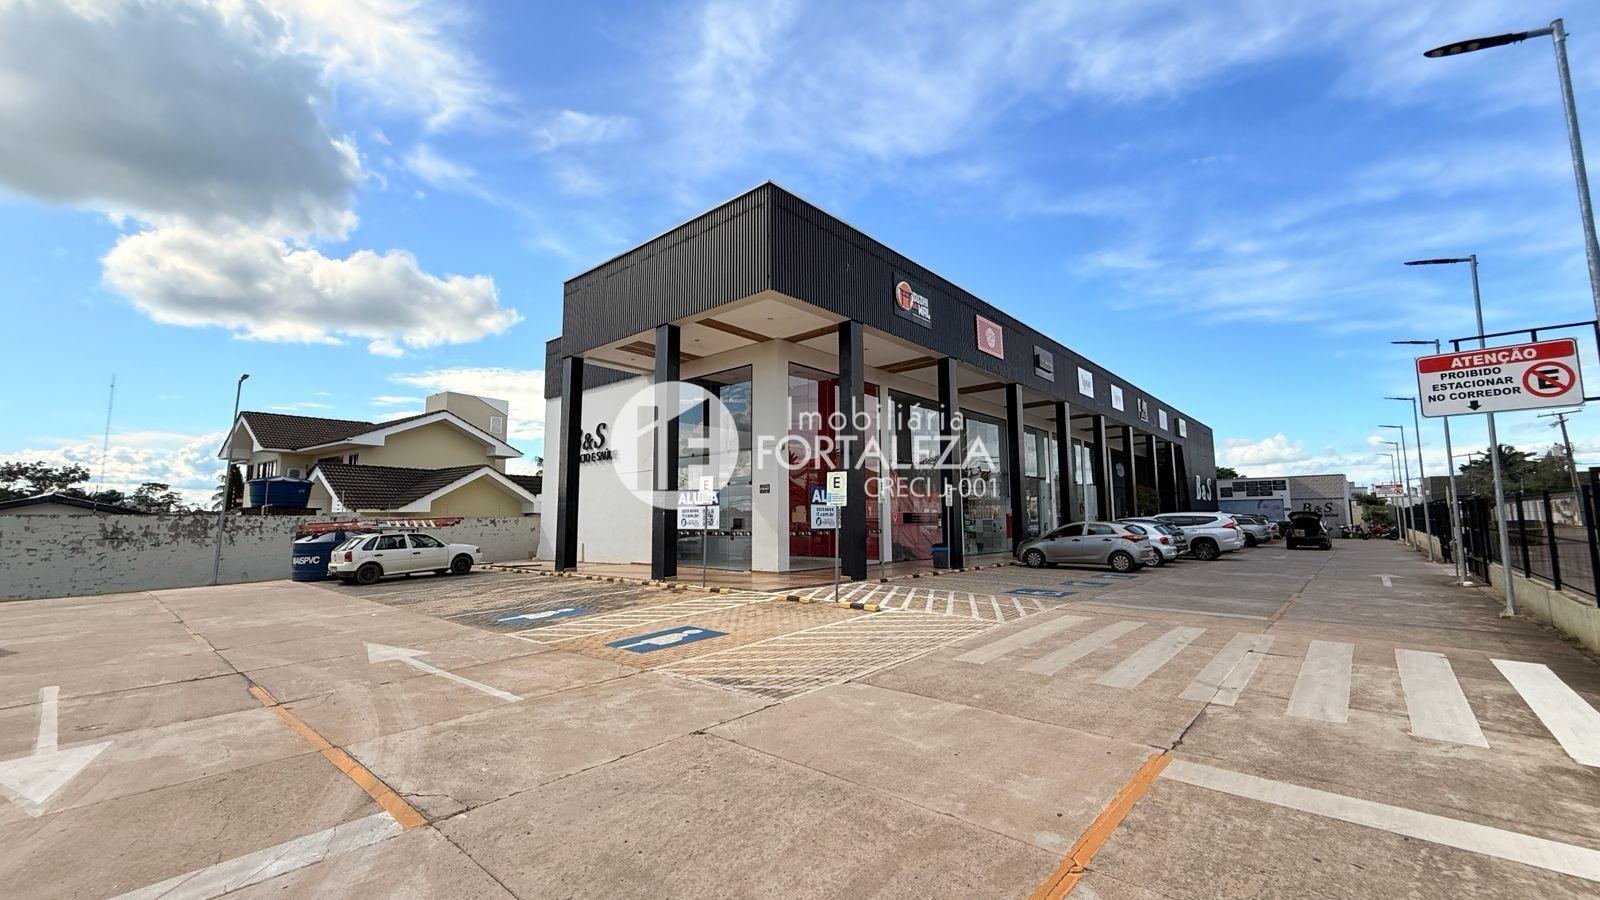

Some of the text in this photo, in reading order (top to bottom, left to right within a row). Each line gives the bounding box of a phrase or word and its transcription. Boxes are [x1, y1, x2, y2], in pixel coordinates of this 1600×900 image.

[1451, 347, 1537, 368] ATENÇÃO
[1440, 367, 1502, 380] PROIBIDO
[1432, 376, 1514, 392] ESTACIONAR
[1428, 386, 1522, 402] NO CORREDOR
[580, 422, 607, 450] &S
[704, 479, 710, 490] E
[834, 476, 840, 488] E
[678, 491, 719, 505] ALUA
